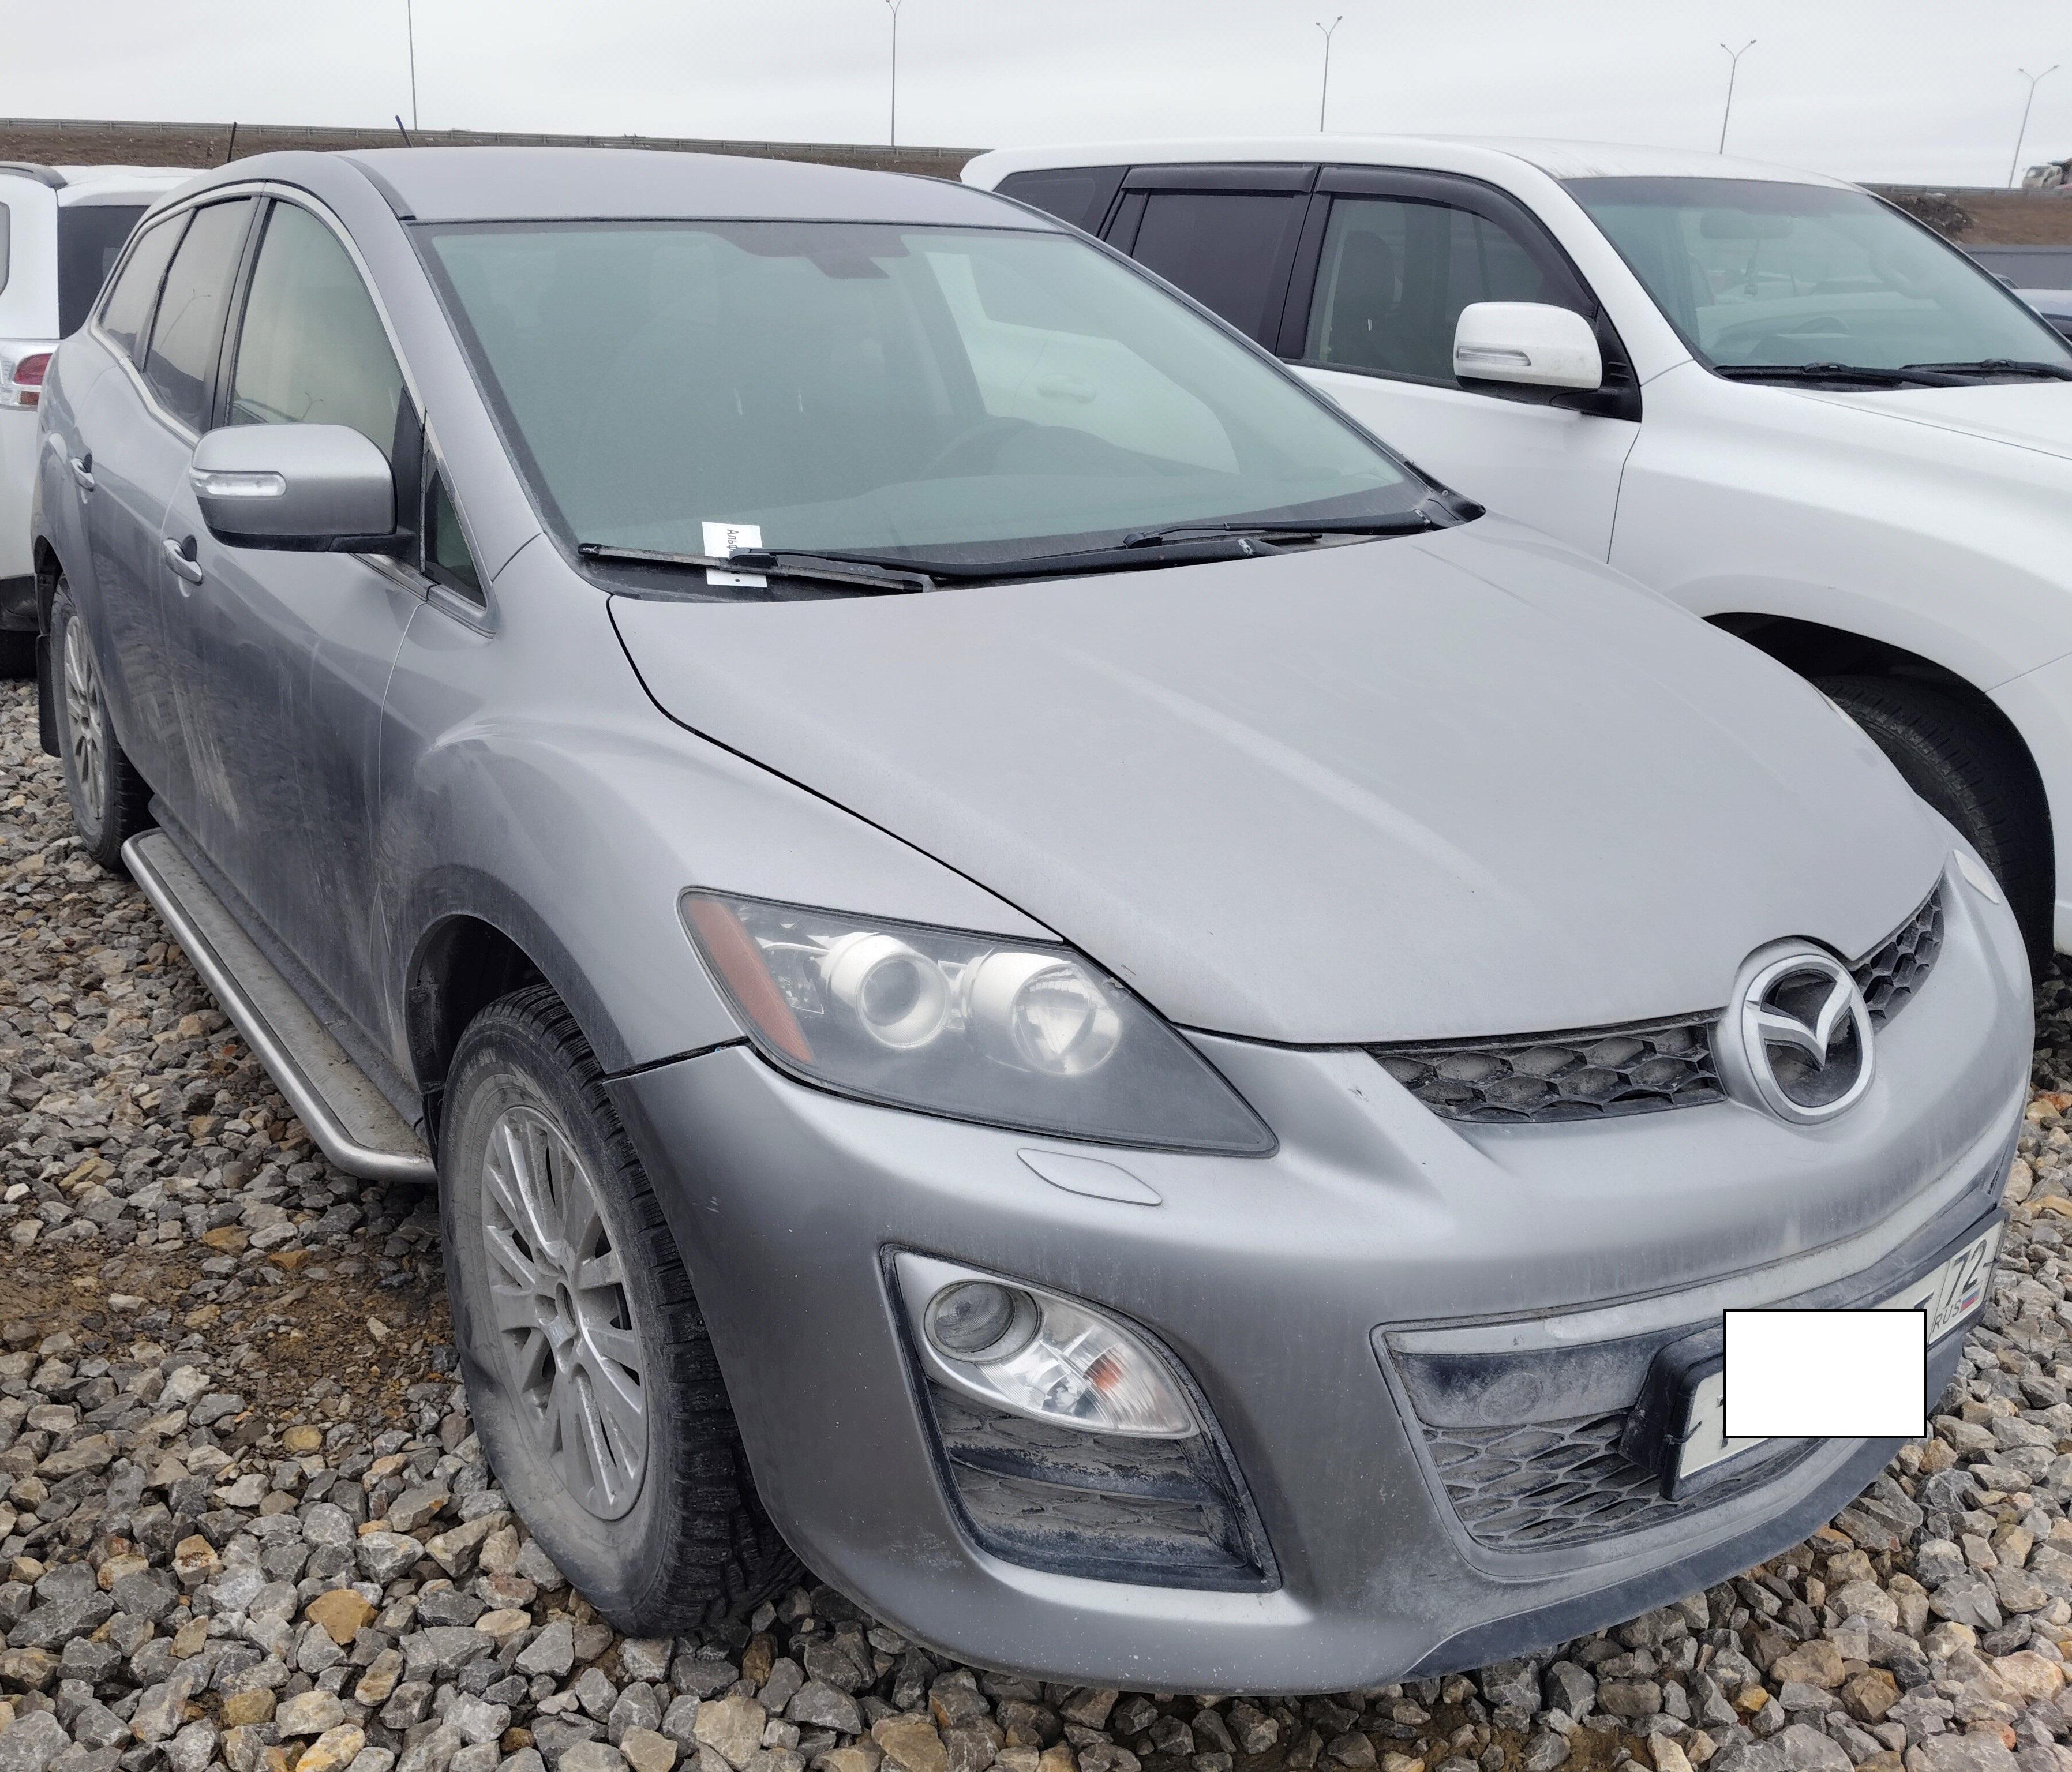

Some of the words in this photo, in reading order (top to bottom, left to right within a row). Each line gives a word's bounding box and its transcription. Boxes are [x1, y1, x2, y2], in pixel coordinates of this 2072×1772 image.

[727, 529, 739, 550] Альф
[1945, 1239, 1988, 1309] 72
[1933, 1298, 1961, 1329] RUS
